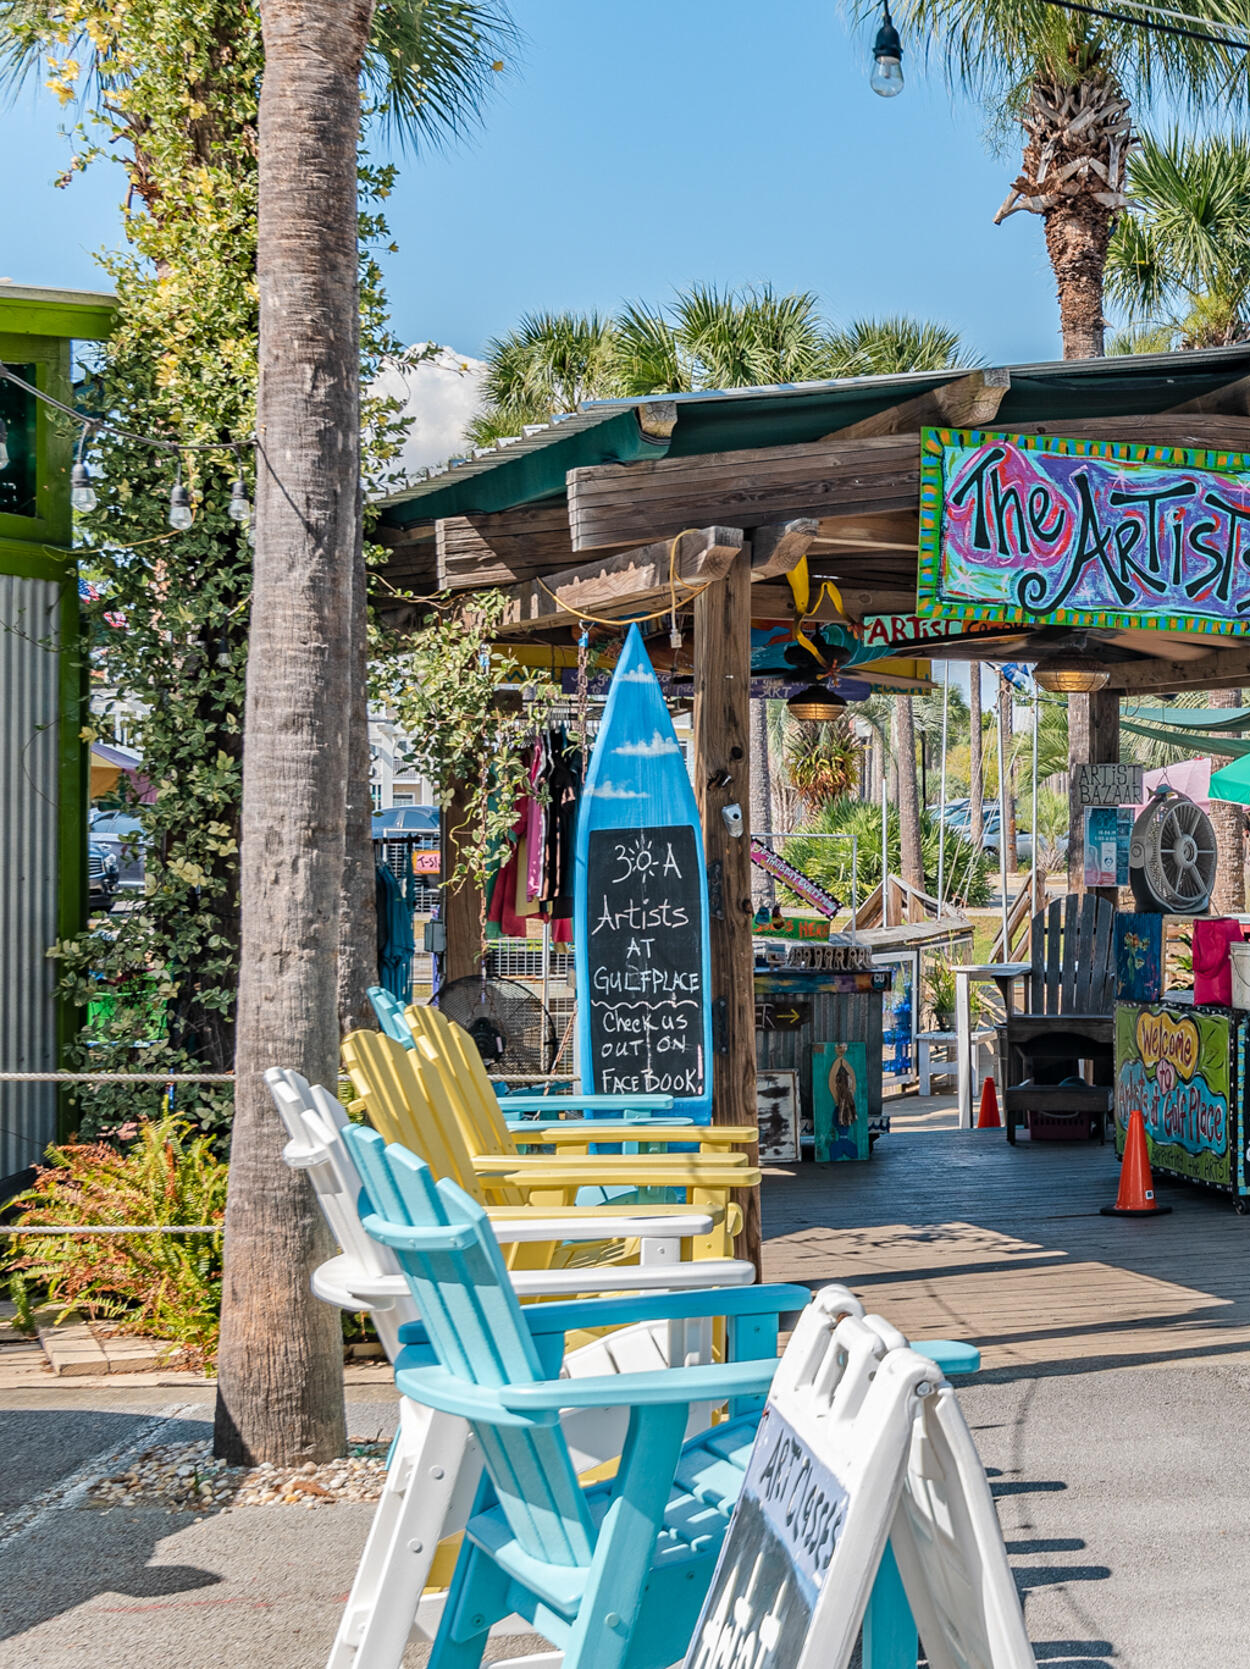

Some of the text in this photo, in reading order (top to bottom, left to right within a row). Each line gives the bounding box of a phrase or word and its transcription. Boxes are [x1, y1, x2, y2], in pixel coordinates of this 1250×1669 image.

[953, 449, 1065, 556] The
[1080, 785, 1143, 804] BAZAAR
[592, 894, 689, 935] Artists
[627, 937, 655, 958] AT
[594, 966, 700, 995] GULFPLACE
[603, 1009, 688, 1033] Check us
[601, 1033, 686, 1058] OUT ON
[1142, 1018, 1192, 1066] Welcome
[1159, 1060, 1172, 1090] to
[1189, 1086, 1222, 1143] Place
[759, 1429, 802, 1503] ART
